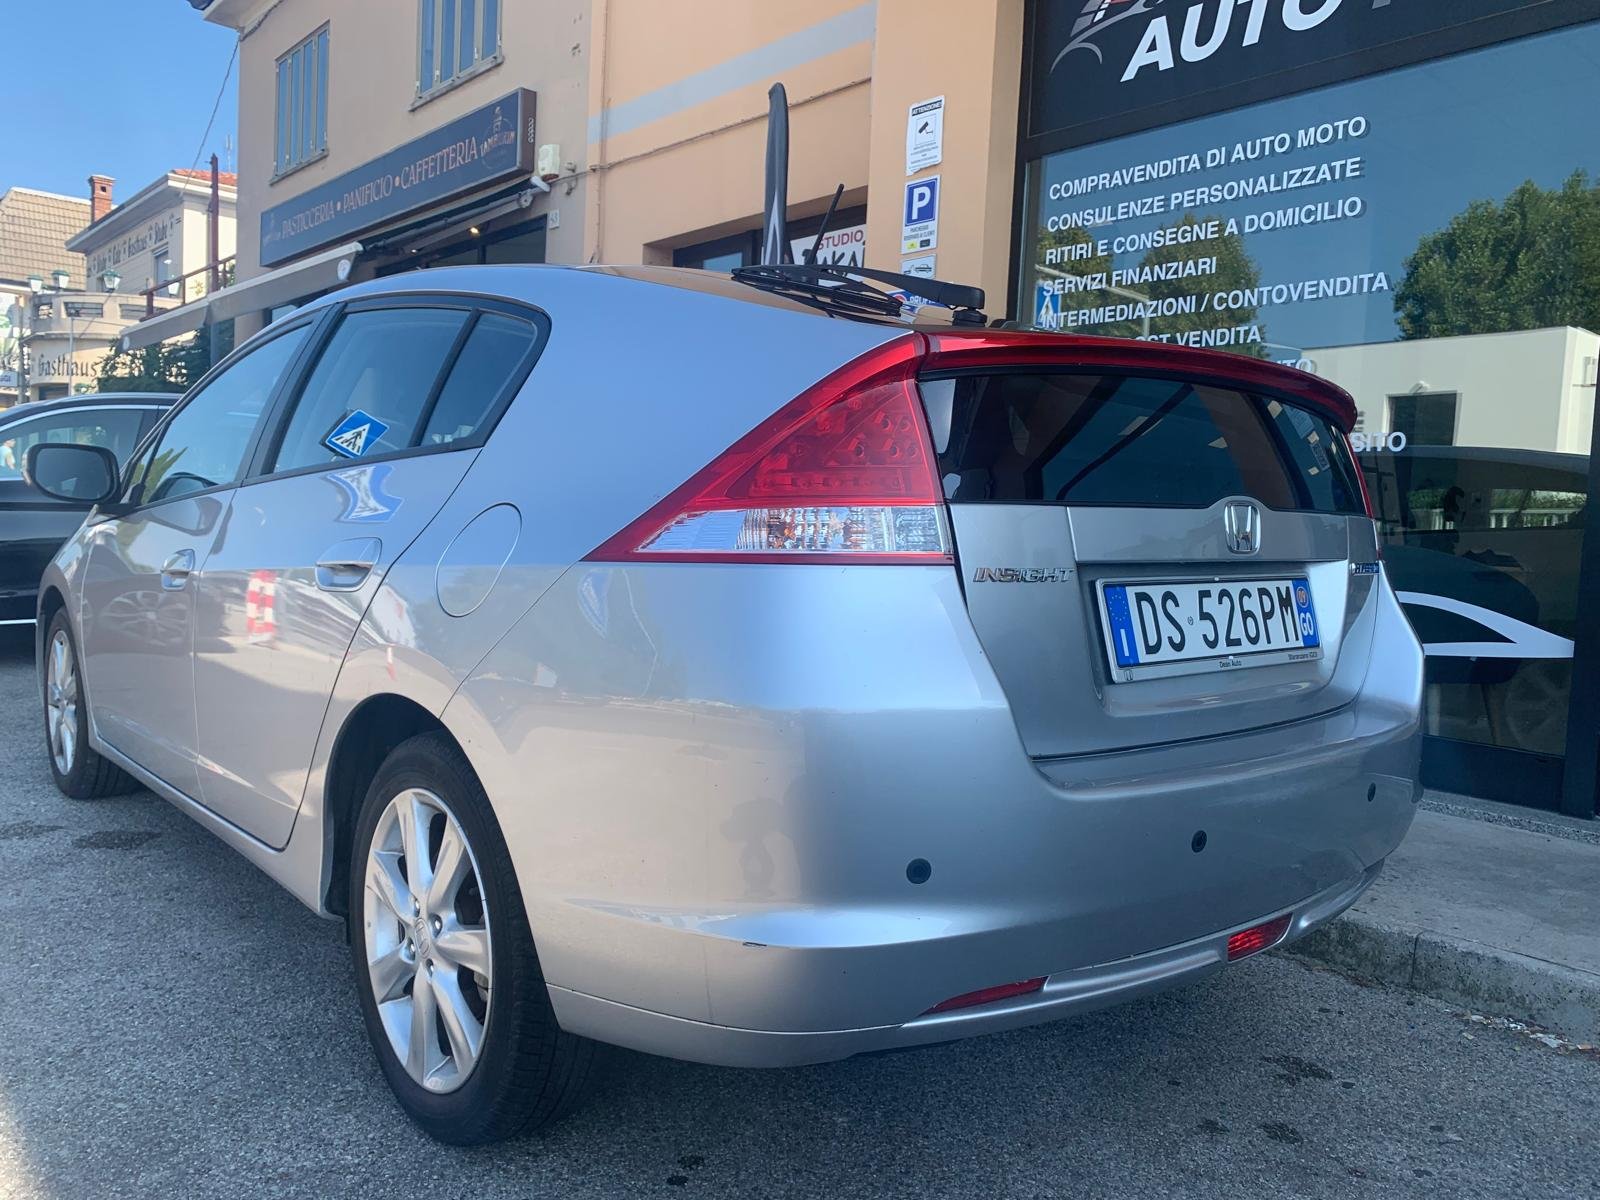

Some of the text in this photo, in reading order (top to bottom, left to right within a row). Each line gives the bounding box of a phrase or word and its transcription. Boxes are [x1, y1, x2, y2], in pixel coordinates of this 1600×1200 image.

[1120, 0, 1341, 83] AUTO
[1049, 116, 1366, 200] COMPRAVENDITA DI AUTO MOTO
[282, 200, 336, 240] PASTICCERIA
[343, 174, 393, 214] PANIFICIO
[401, 135, 478, 190] CAFFETTERIA
[911, 186, 931, 220] P
[1047, 156, 1361, 232] CONSULENZE PERSONALIZZATE
[818, 229, 864, 250] STUDIO
[1045, 196, 1362, 265] RITIRI E CONSEGNE A DOMICILIO
[1041, 271, 1389, 328] INTERMEDIAZIONI / CONTOVENDITA
[1042, 256, 1217, 297] SERVIZI FINANZIARI
[1176, 325, 1262, 348] VENDITA
[38, 353, 97, 377] Gasthaus
[973, 567, 1074, 583] INSIGHT
[1134, 585, 1300, 656] DS 526PM
[1299, 612, 1314, 636] GO
